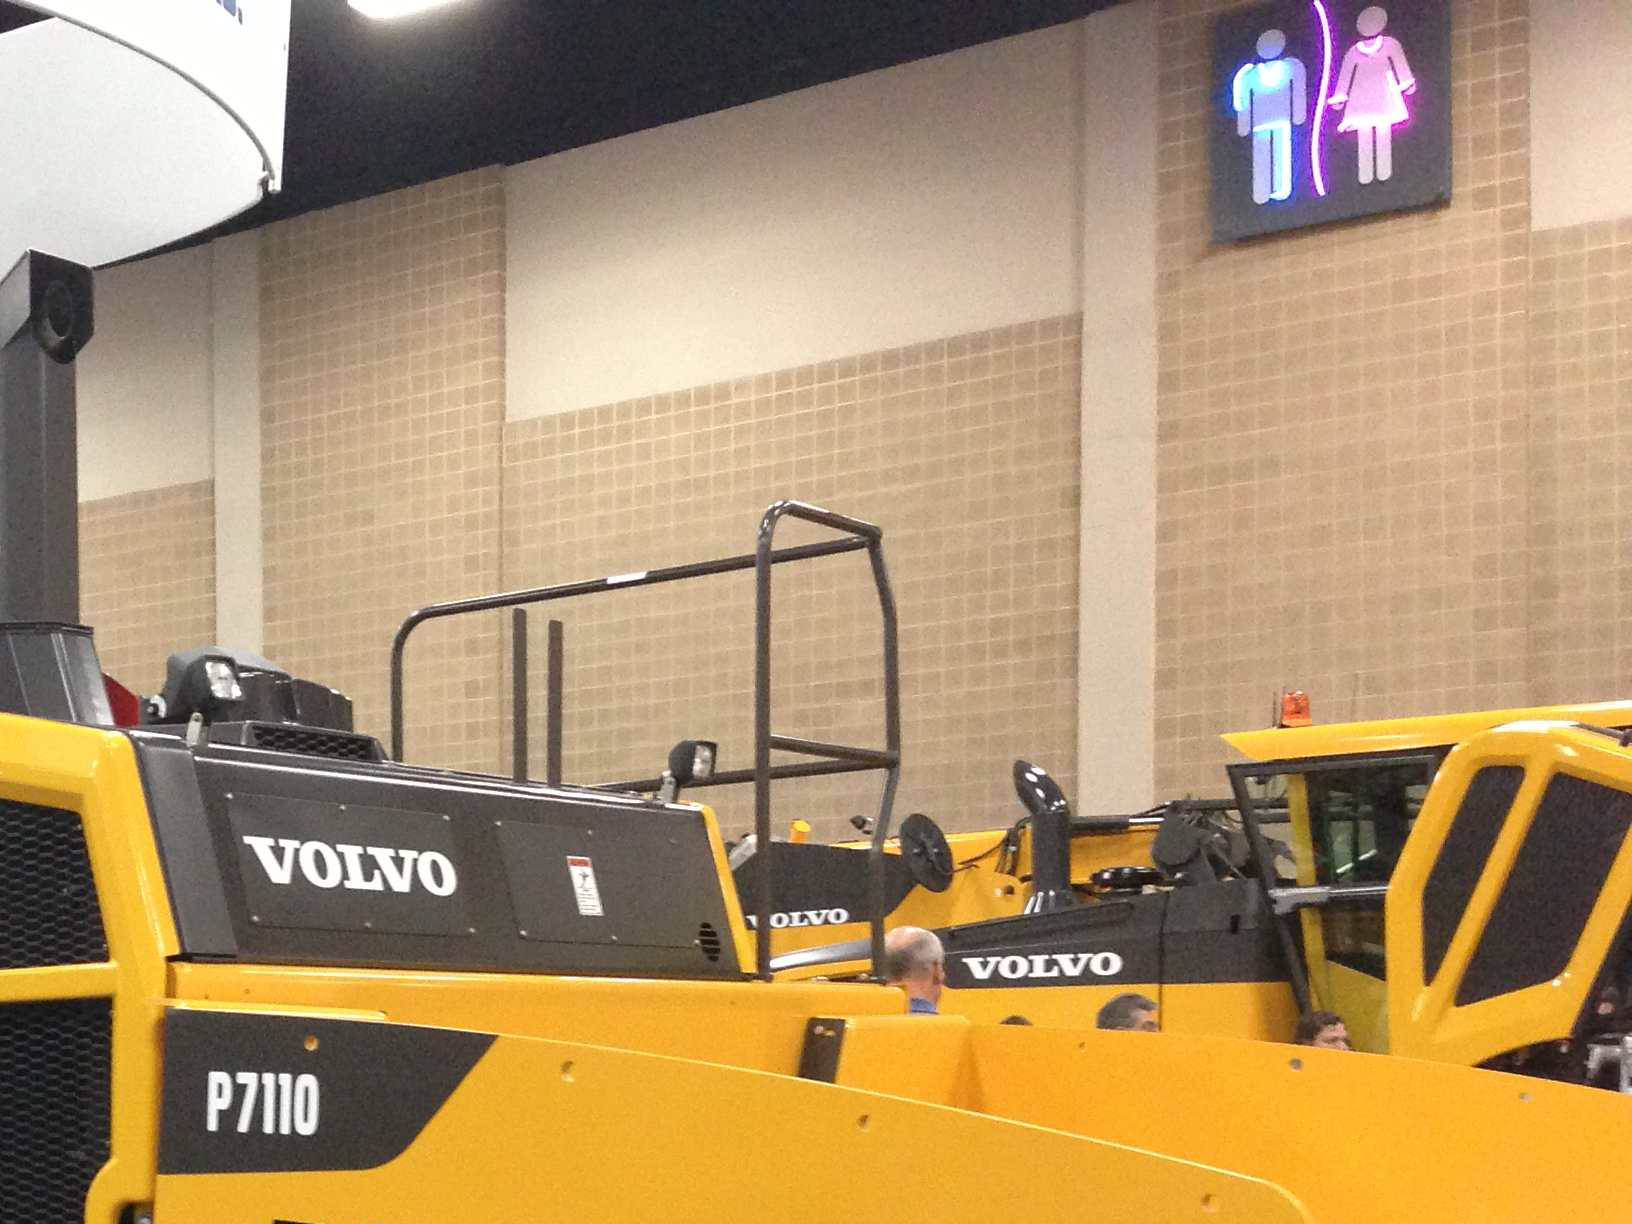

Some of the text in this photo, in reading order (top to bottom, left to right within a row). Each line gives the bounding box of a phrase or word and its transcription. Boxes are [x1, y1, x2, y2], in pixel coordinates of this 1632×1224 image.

[242, 835, 458, 897] VOLVO
[961, 951, 1123, 980] VOLVO
[206, 1071, 320, 1136] P7110
